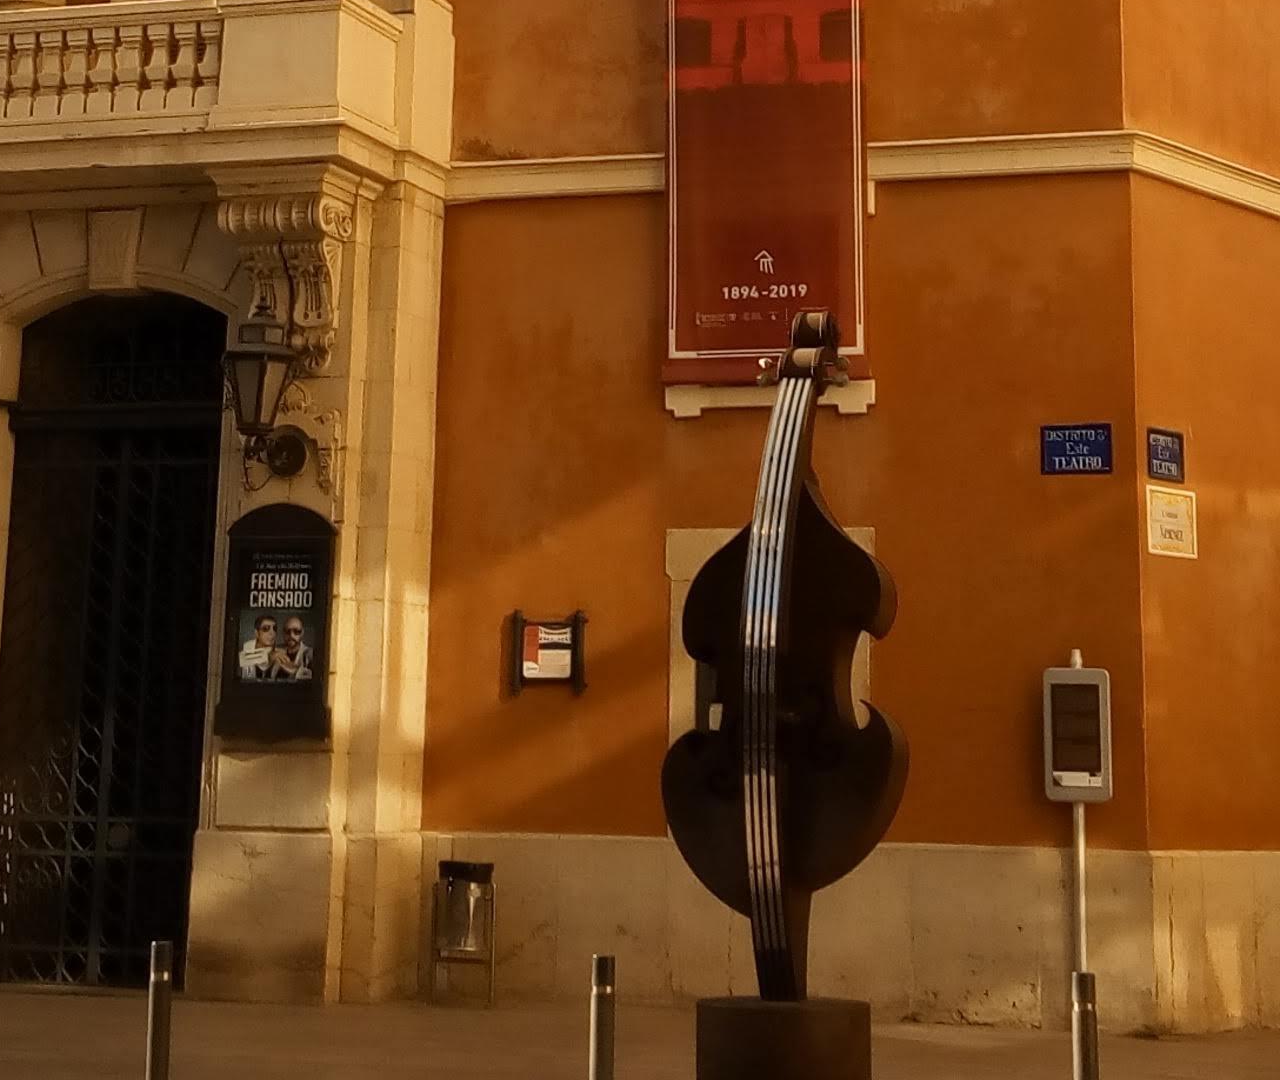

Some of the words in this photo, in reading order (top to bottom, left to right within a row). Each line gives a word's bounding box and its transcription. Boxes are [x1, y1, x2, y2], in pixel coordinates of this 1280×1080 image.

[722, 284, 808, 300] 1894-2019
[1044, 430, 1095, 441] DISTRITO
[1052, 456, 1102, 471] TEATRO
[250, 572, 309, 590] FAEMINO
[249, 591, 314, 608] CANSADO
